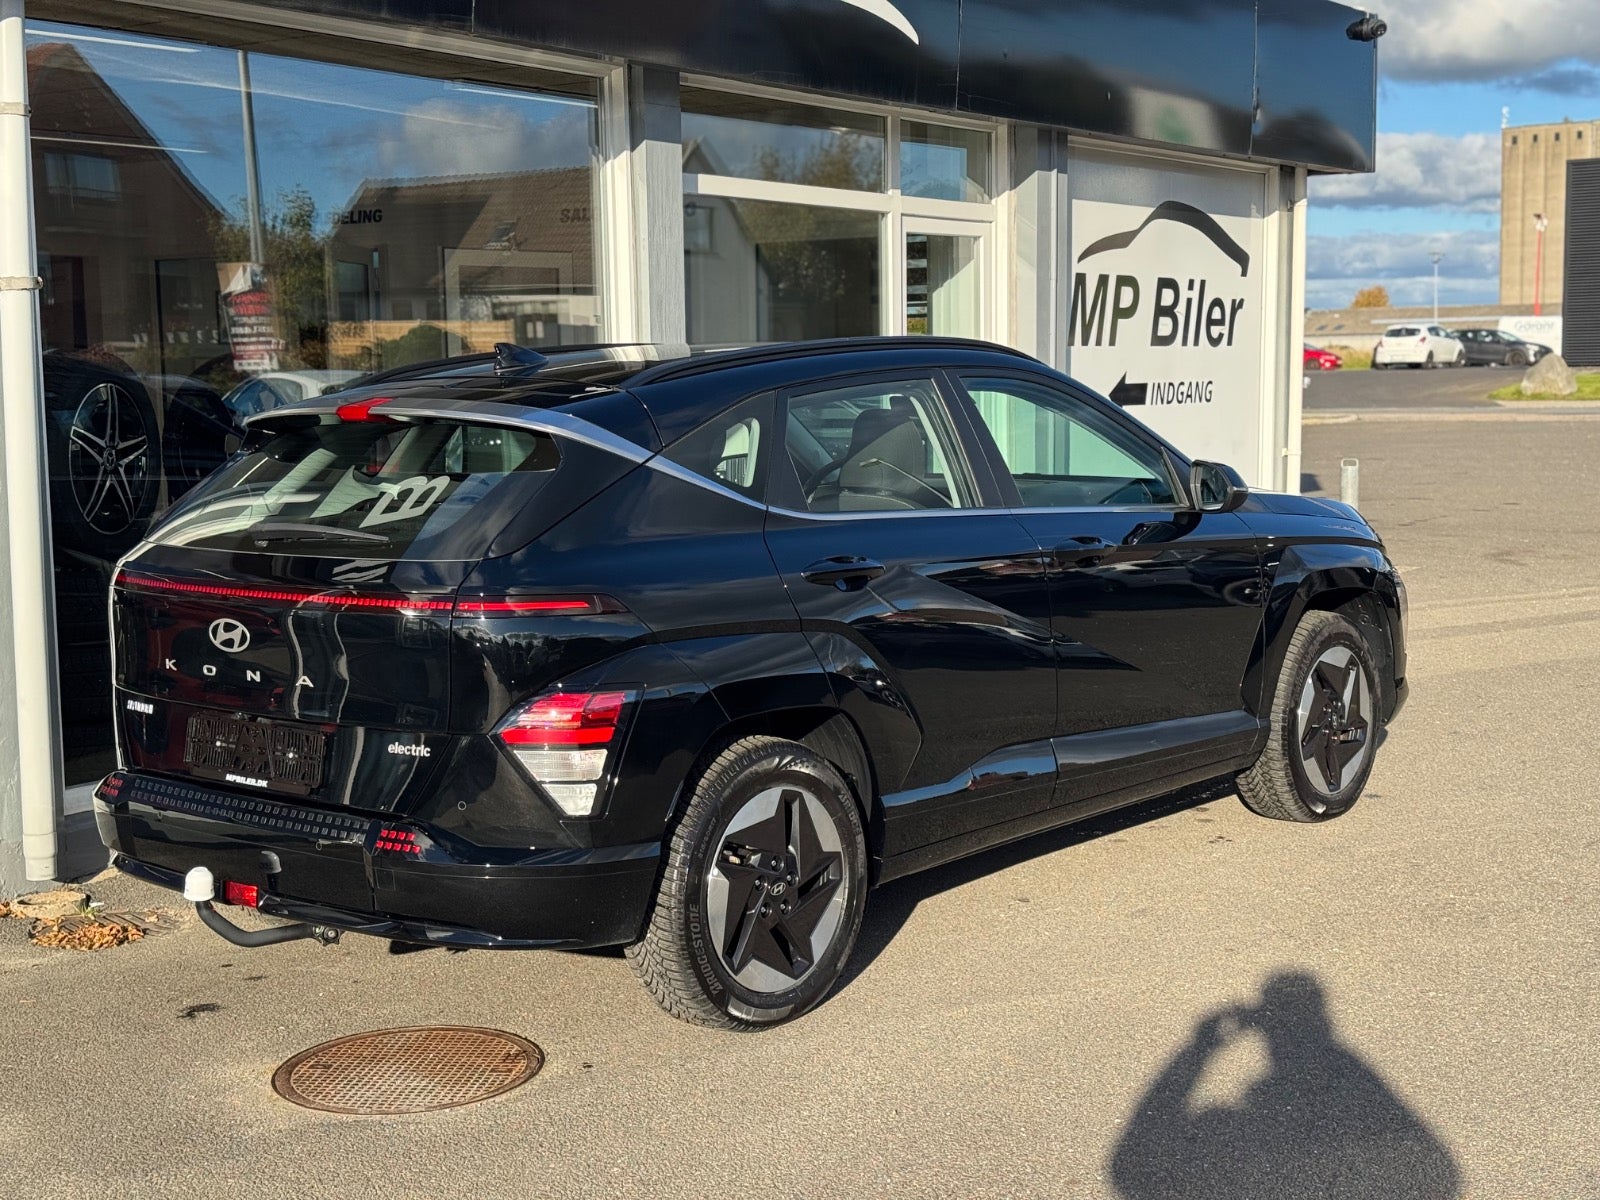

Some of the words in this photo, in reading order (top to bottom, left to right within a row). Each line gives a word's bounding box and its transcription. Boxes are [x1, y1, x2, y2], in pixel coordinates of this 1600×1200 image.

[1067, 272, 1141, 347] MP
[1150, 276, 1245, 348] Biler
[1150, 380, 1213, 406] INDGANG
[165, 658, 314, 687] KONA
[388, 741, 431, 757] electric
[689, 903, 724, 996] BRIDGESTONE
